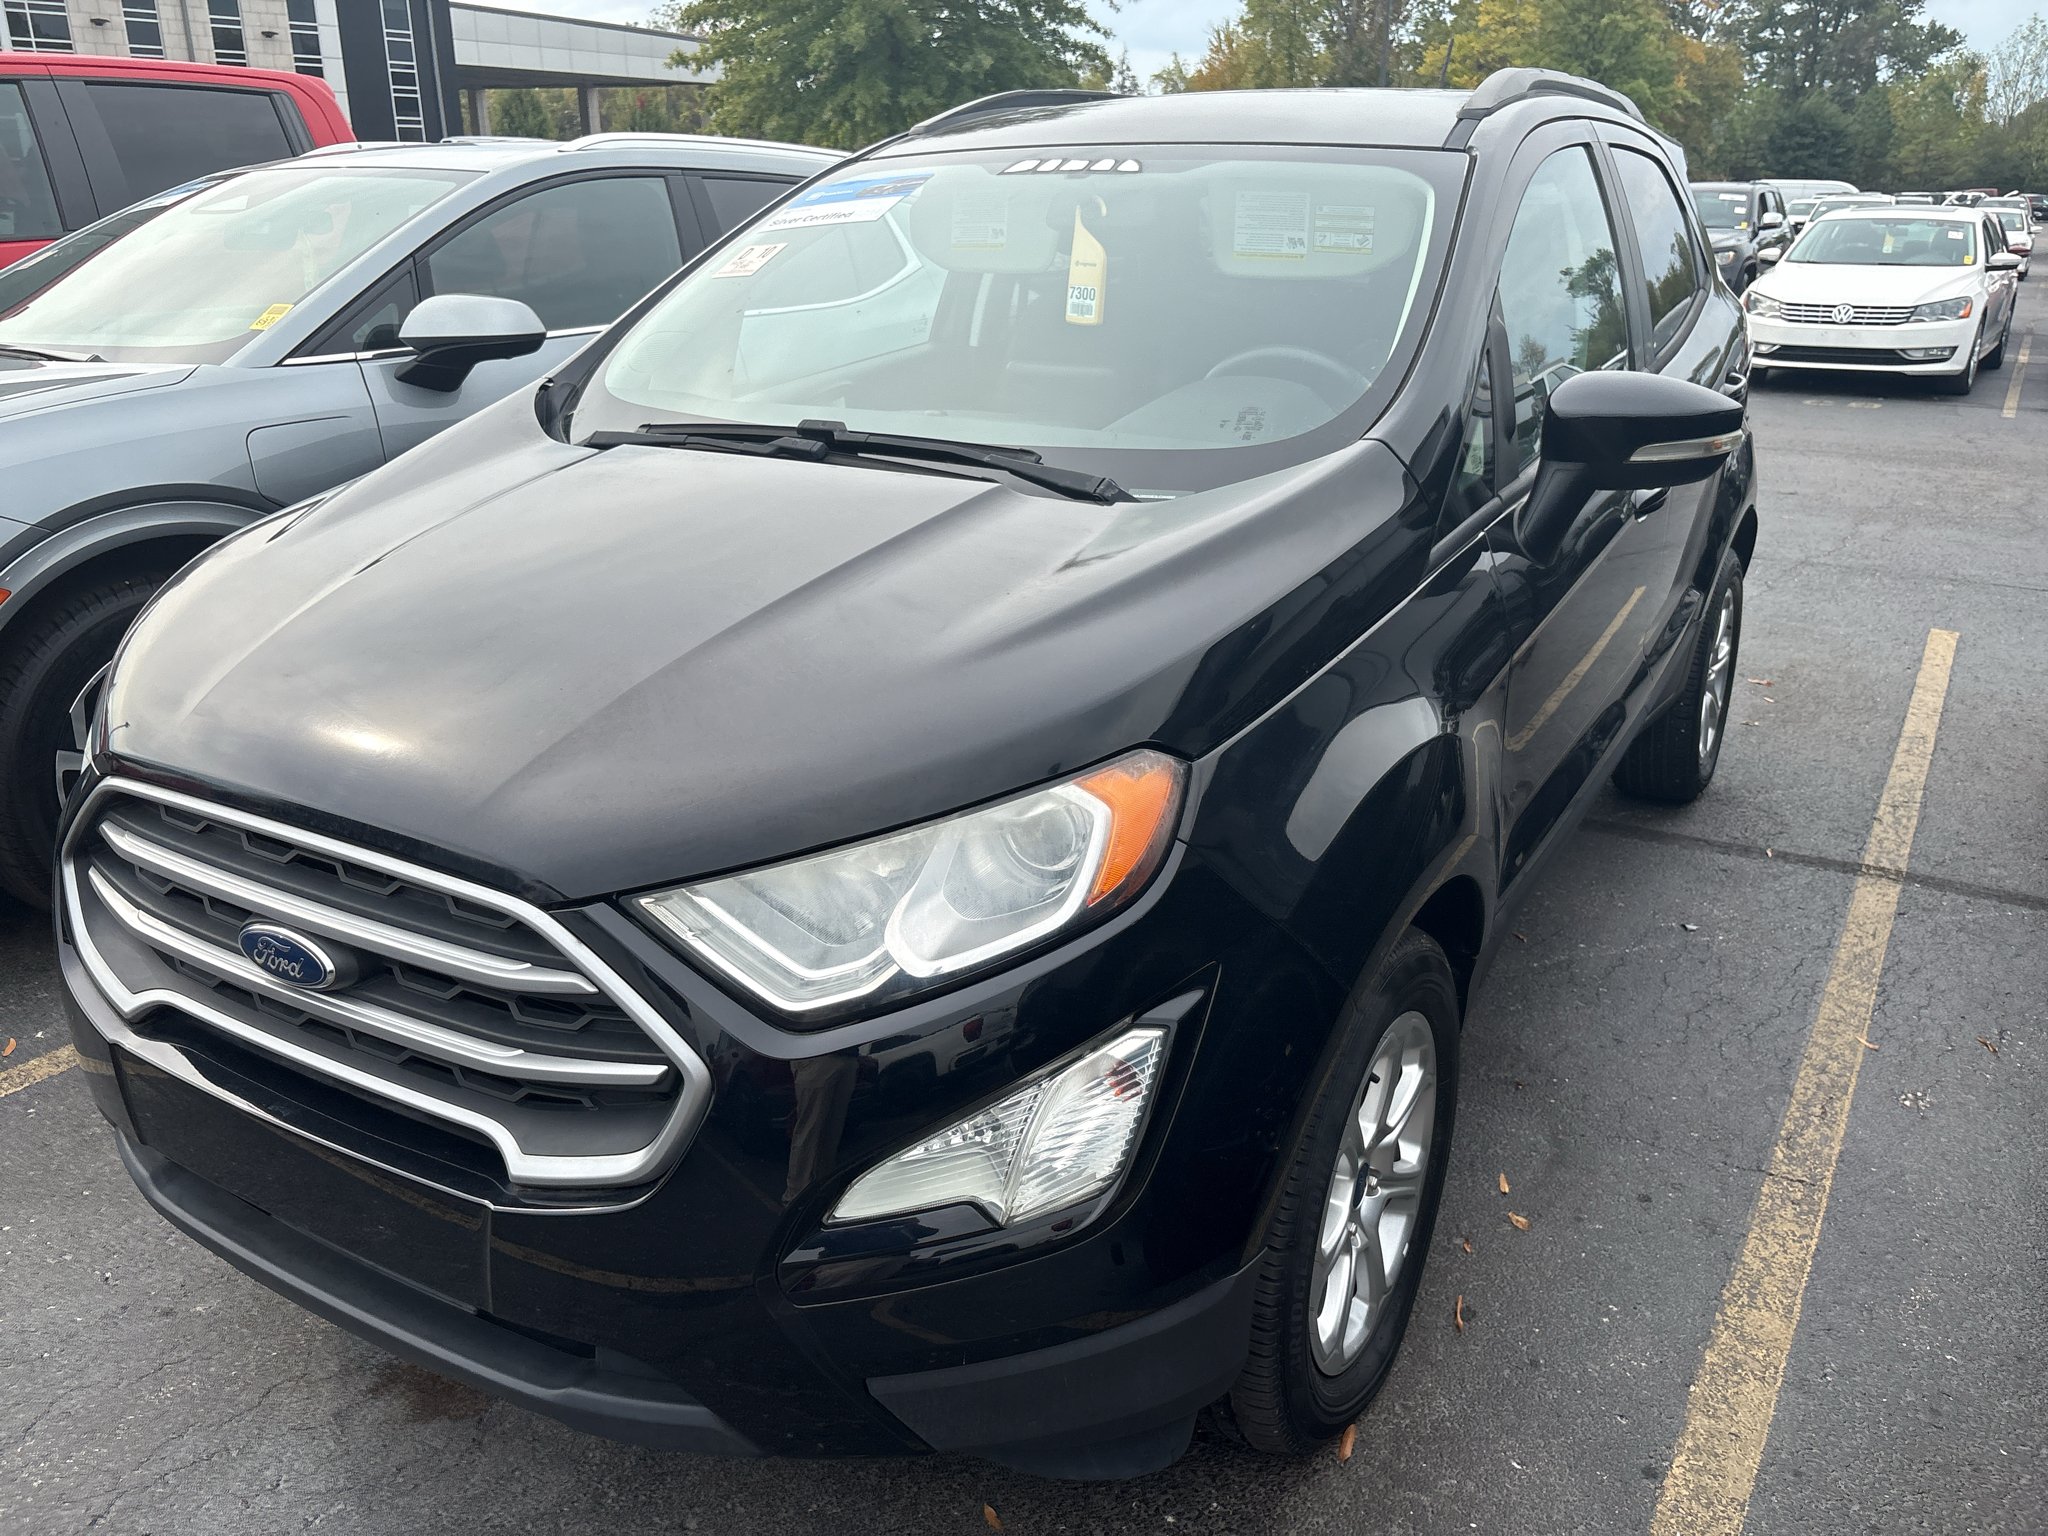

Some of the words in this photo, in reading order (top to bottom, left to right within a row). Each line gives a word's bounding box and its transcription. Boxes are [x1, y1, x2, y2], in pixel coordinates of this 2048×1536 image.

[769, 216, 803, 227] Silver
[802, 211, 855, 223] Certified
[1069, 287, 1096, 301] 7300
[254, 936, 303, 978] Ford
